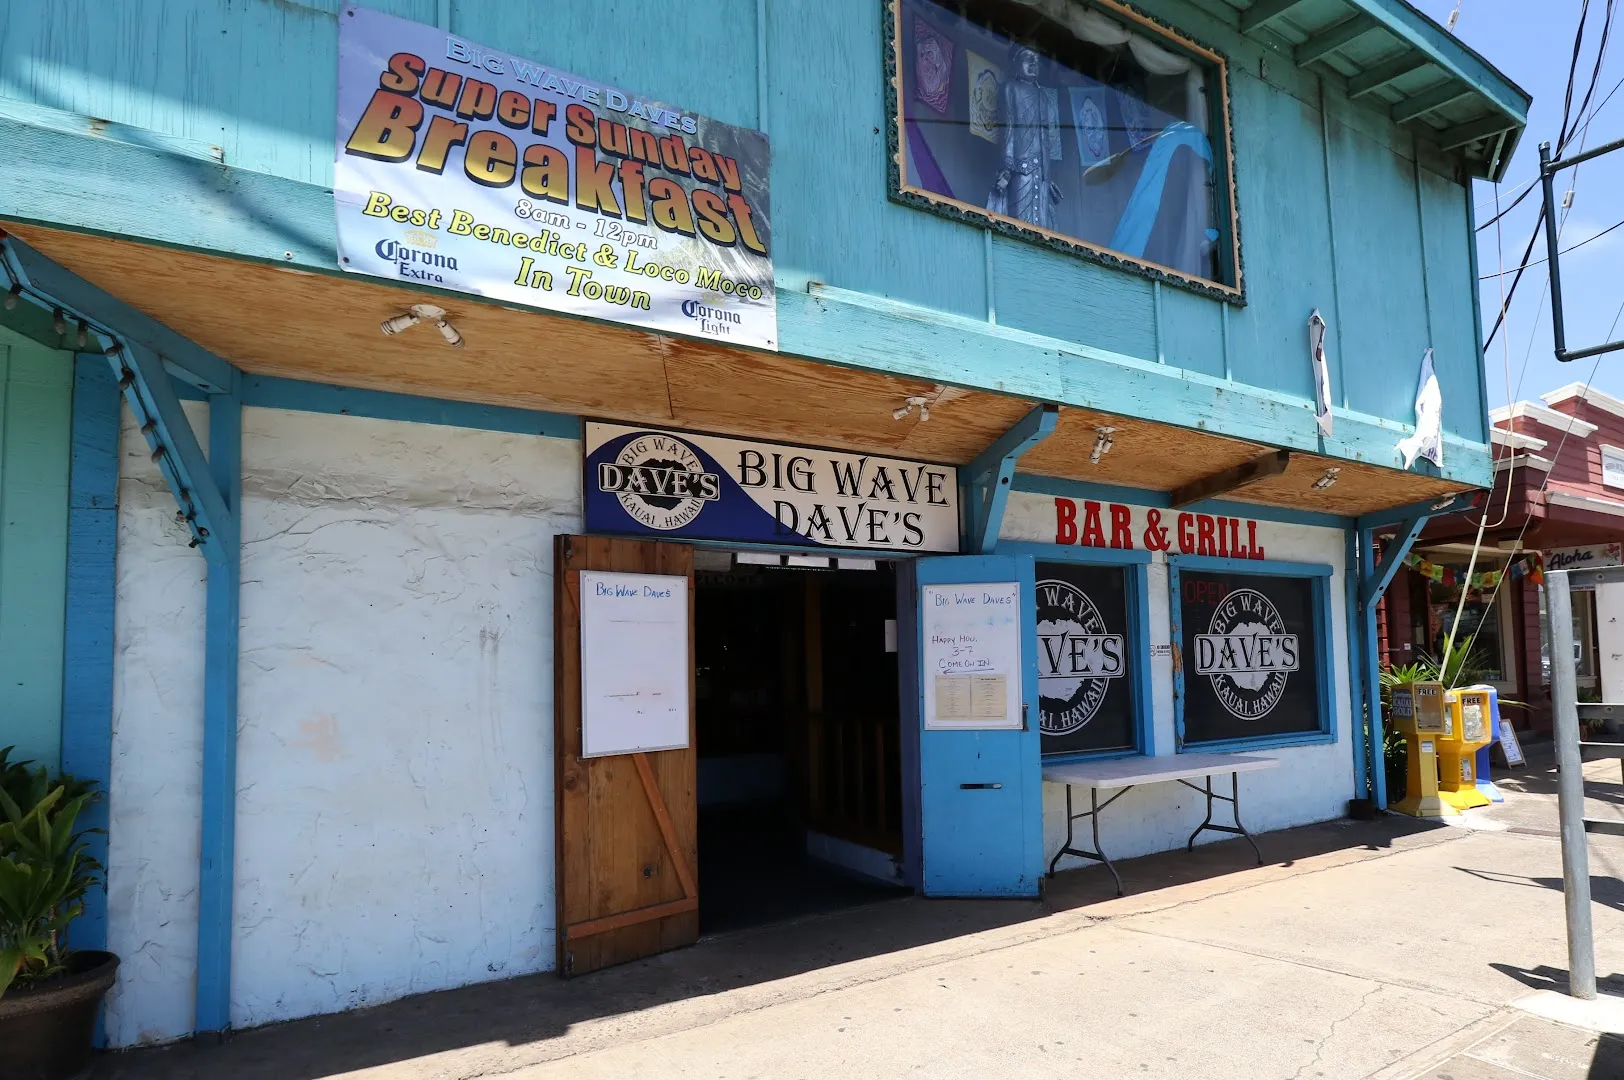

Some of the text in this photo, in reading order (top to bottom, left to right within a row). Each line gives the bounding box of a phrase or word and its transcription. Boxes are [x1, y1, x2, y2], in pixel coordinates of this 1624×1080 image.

[379, 52, 742, 195] Super Sunday
[345, 88, 768, 259] Breakfast
[514, 199, 571, 230] 8am
[594, 218, 659, 250] 12pm
[362, 190, 763, 301] Best Benedict & Loco Moco
[374, 238, 460, 272] Corona
[399, 262, 444, 284] Extra
[514, 256, 652, 311] In Town
[681, 299, 743, 326] Corona
[699, 317, 732, 336] Light
[621, 437, 700, 472] BIG WAVE
[599, 463, 719, 500] DAVE'S
[737, 449, 951, 508] BIG WAVE
[664, 499, 701, 527] HAWAII
[772, 499, 926, 548] DAVE'S
[1054, 497, 1264, 561] BAR & GRILL
[1546, 548, 1594, 570] Aloha
[954, 592, 976, 605] WAVE
[1044, 584, 1100, 634] WAVE
[1214, 592, 1281, 635] BIG WAVE
[938, 657, 963, 669] COME
[978, 657, 990, 667] IN
[1038, 631, 1122, 676] VE'S
[1196, 632, 1298, 670] DAVE'S
[1060, 678, 1104, 728] HAWAII
[1252, 673, 1286, 714] HAWAII
[1462, 697, 1481, 705] FREE
